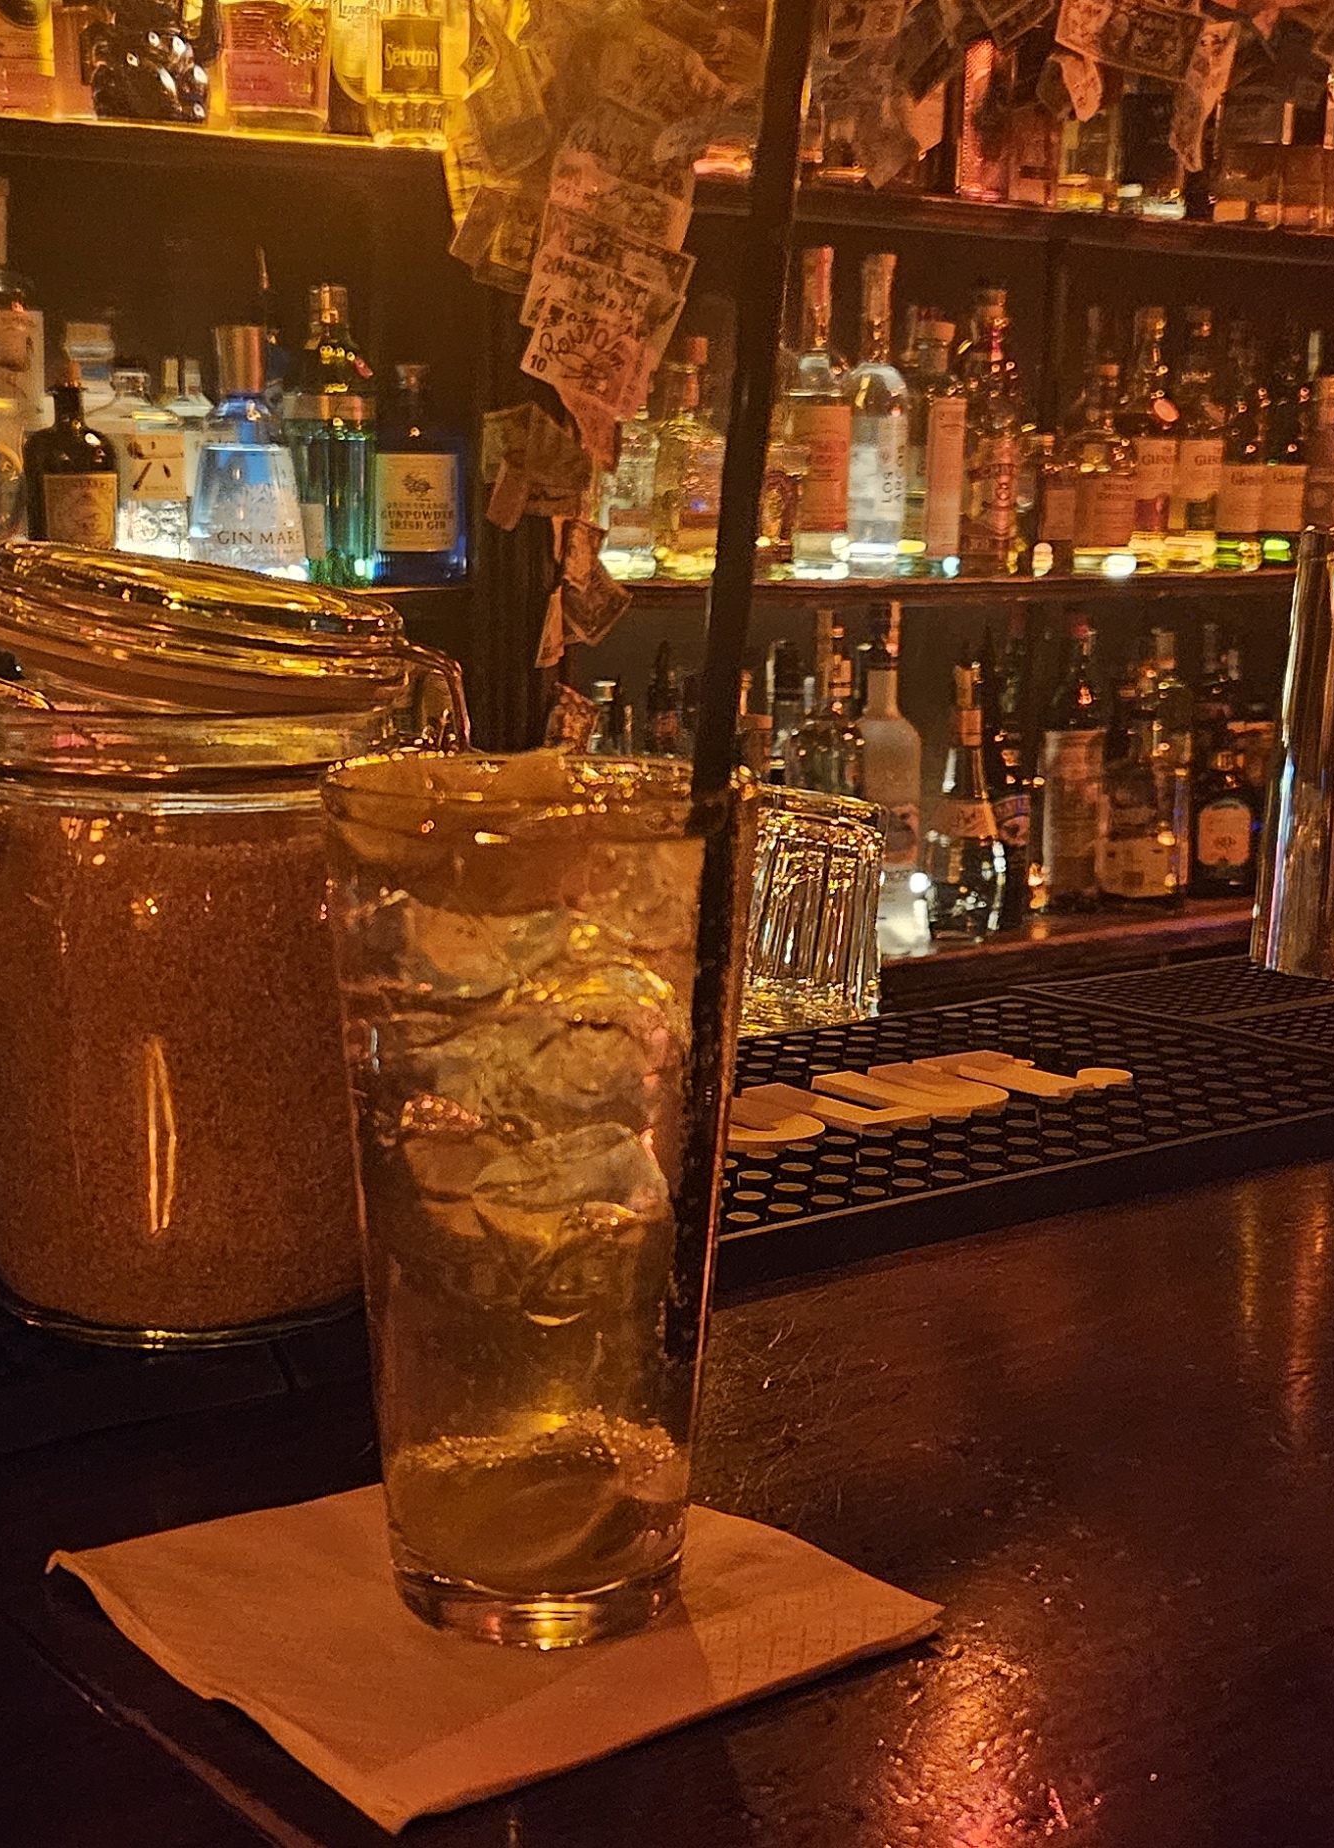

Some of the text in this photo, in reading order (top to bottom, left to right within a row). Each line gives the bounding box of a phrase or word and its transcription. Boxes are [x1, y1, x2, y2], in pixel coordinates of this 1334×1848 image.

[384, 43, 439, 71] Serum
[529, 353, 548, 373] 10
[881, 471, 893, 504] LOS
[217, 529, 302, 545] GIN MARE
